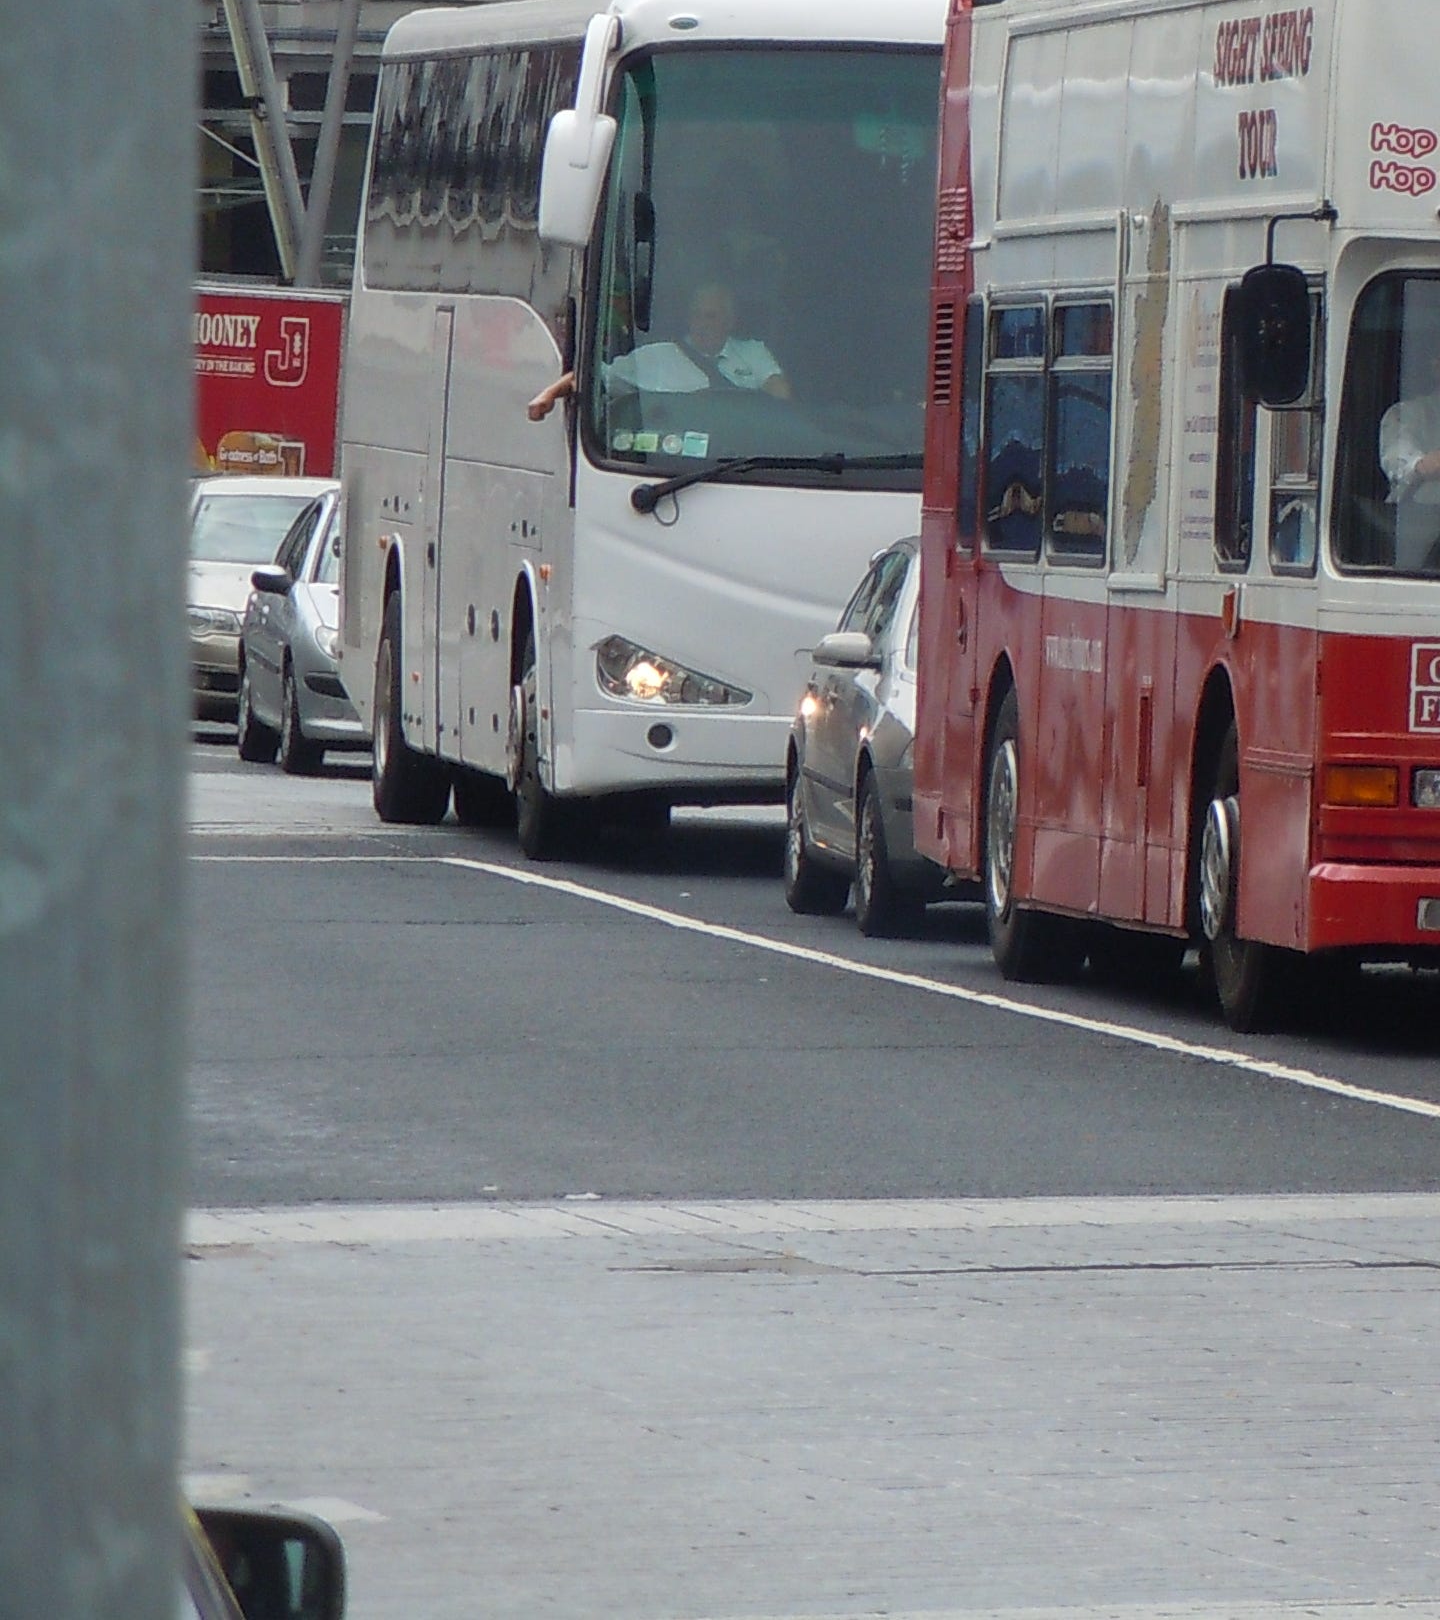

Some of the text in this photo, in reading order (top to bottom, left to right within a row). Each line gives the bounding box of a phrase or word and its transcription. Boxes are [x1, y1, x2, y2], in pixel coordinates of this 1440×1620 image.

[1214, 16, 1261, 89] SIGHT
[1238, 108, 1278, 180] TOUR
[1371, 122, 1438, 159] Hop
[1369, 160, 1437, 197] Hop
